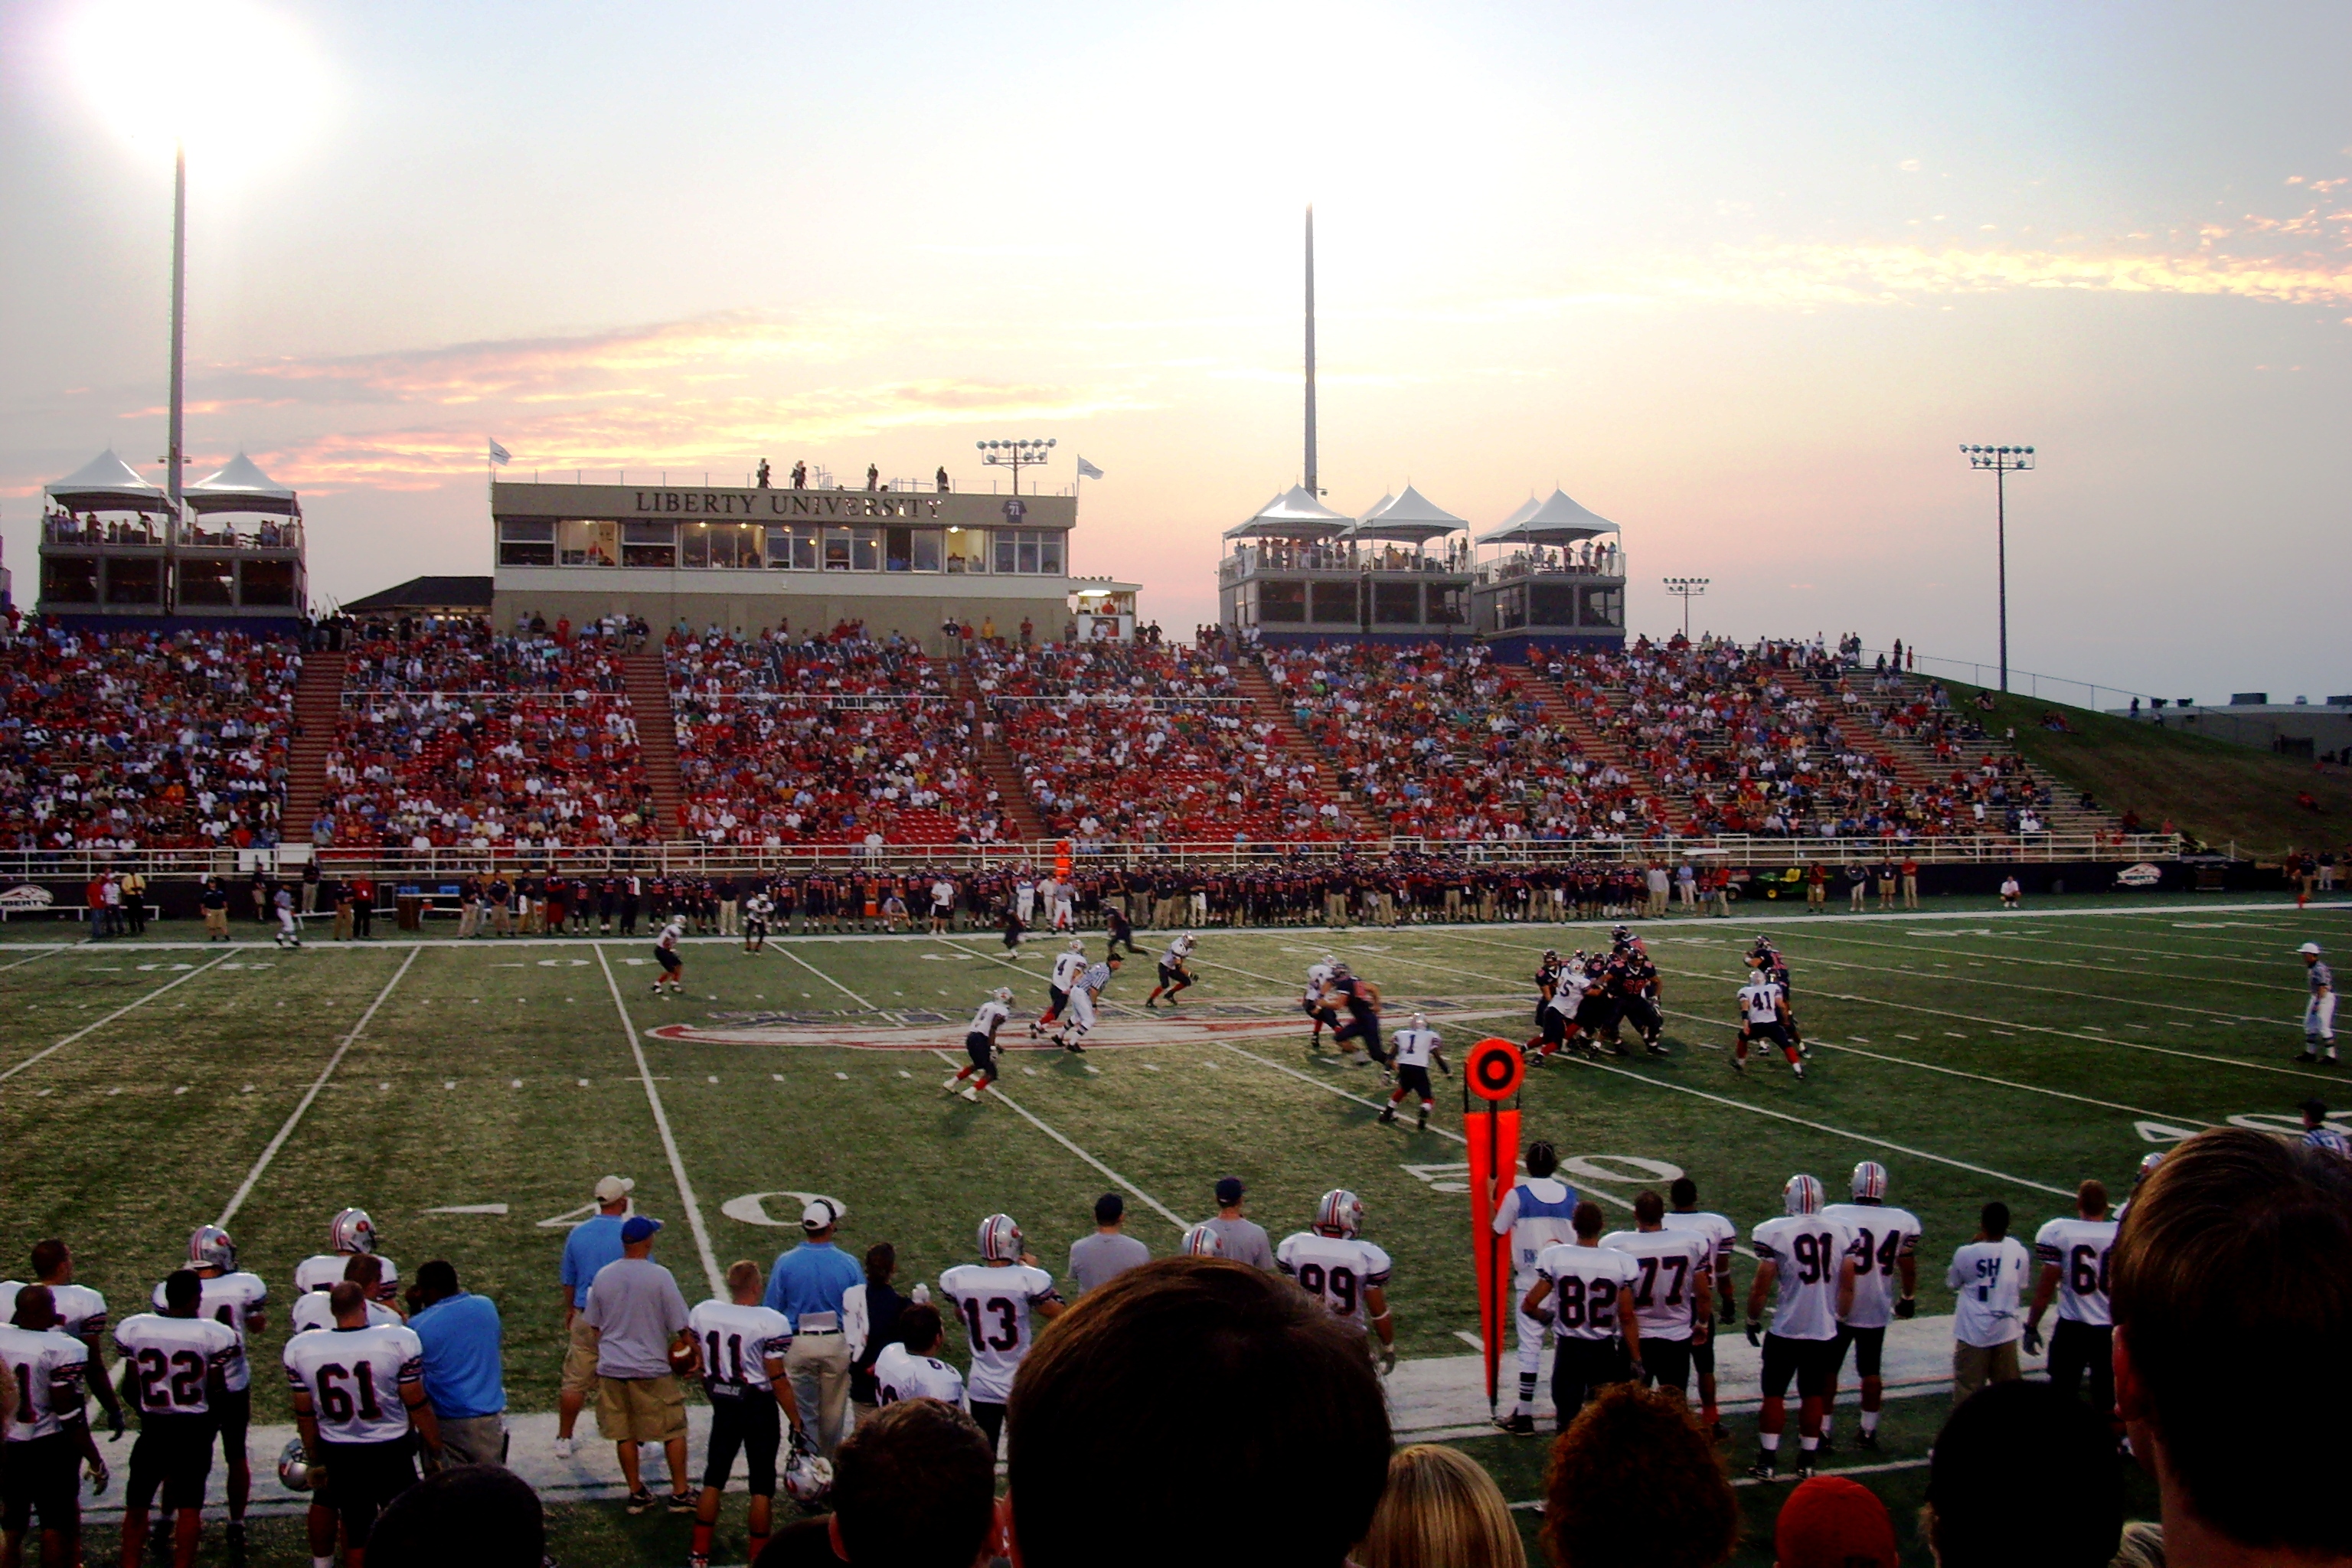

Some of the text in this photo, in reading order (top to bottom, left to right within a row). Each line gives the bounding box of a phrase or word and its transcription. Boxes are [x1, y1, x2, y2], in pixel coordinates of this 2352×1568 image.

[635, 492, 943, 518] LIBERTY UNIVERSITY
[1008, 505, 1020, 516] 71
[1057, 959, 1067, 976] 4
[1752, 991, 1773, 1011] 41
[1406, 1034, 1416, 1054] 1
[1633, 1256, 1687, 1306] 77
[1793, 1232, 1833, 1285] 91
[1299, 1264, 1357, 1316] 99
[1558, 1276, 1617, 1328] 82
[964, 1297, 1018, 1352] 13
[138, 1348, 205, 1407] 22
[705, 1330, 750, 1387] 11
[316, 1361, 382, 1423] 61
